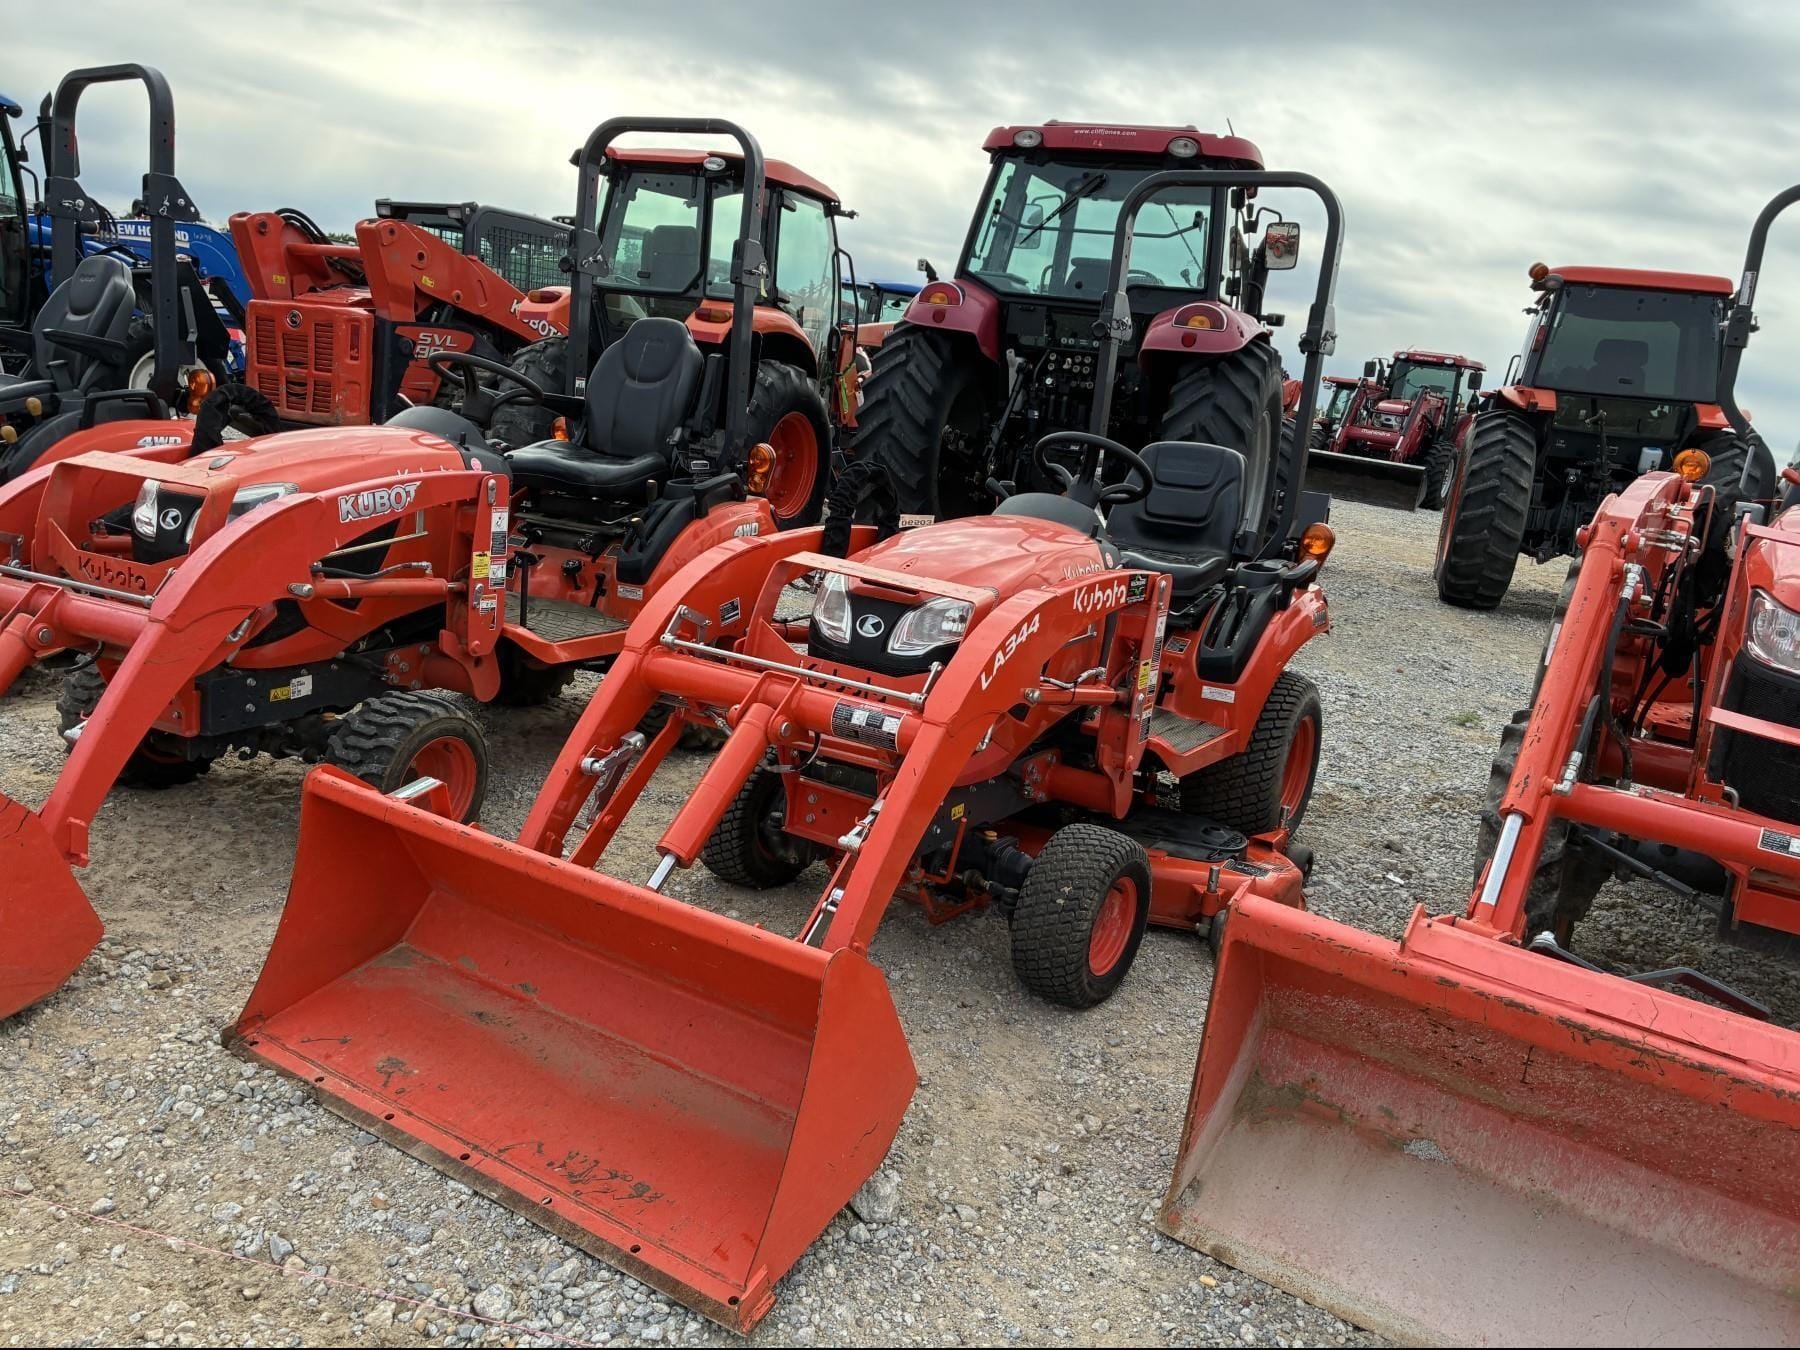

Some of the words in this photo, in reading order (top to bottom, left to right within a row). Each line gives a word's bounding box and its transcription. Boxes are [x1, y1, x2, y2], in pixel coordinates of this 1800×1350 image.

[511, 299, 562, 336] KBOT
[418, 332, 457, 346] SVL
[733, 522, 759, 537] 4WD
[79, 555, 146, 591] Kubota
[1063, 560, 1101, 580] Kubota
[1073, 580, 1127, 613] Kubota
[981, 612, 1040, 691] LA344
